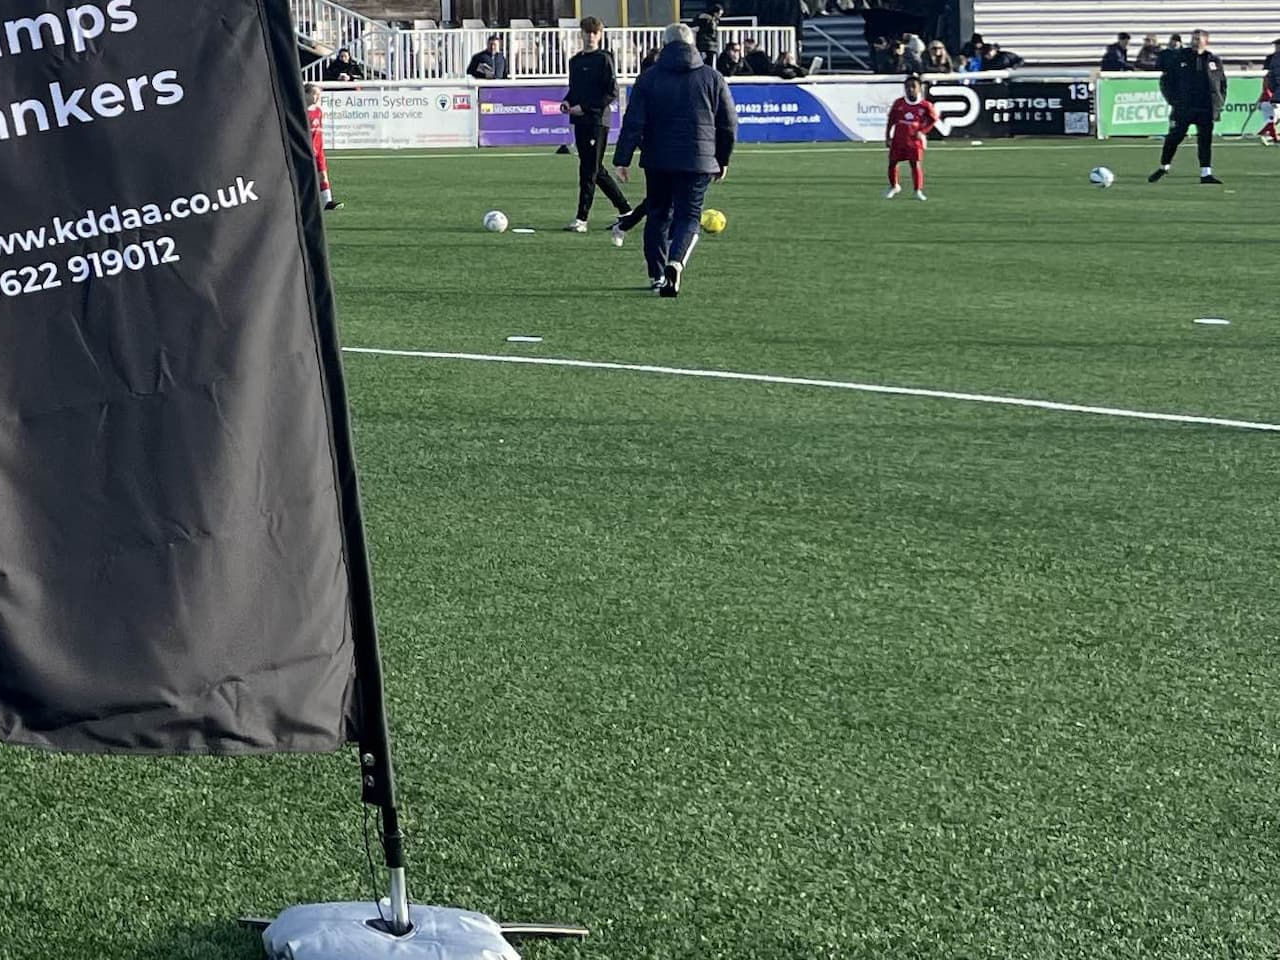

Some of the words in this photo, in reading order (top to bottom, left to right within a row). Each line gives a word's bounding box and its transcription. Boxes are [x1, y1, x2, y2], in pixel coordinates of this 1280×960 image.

[320, 96, 342, 107] Fire
[345, 96, 379, 107] Alarm
[382, 95, 429, 110] Systems
[322, 109, 370, 119] nstallation
[67, 236, 180, 282] 919012
